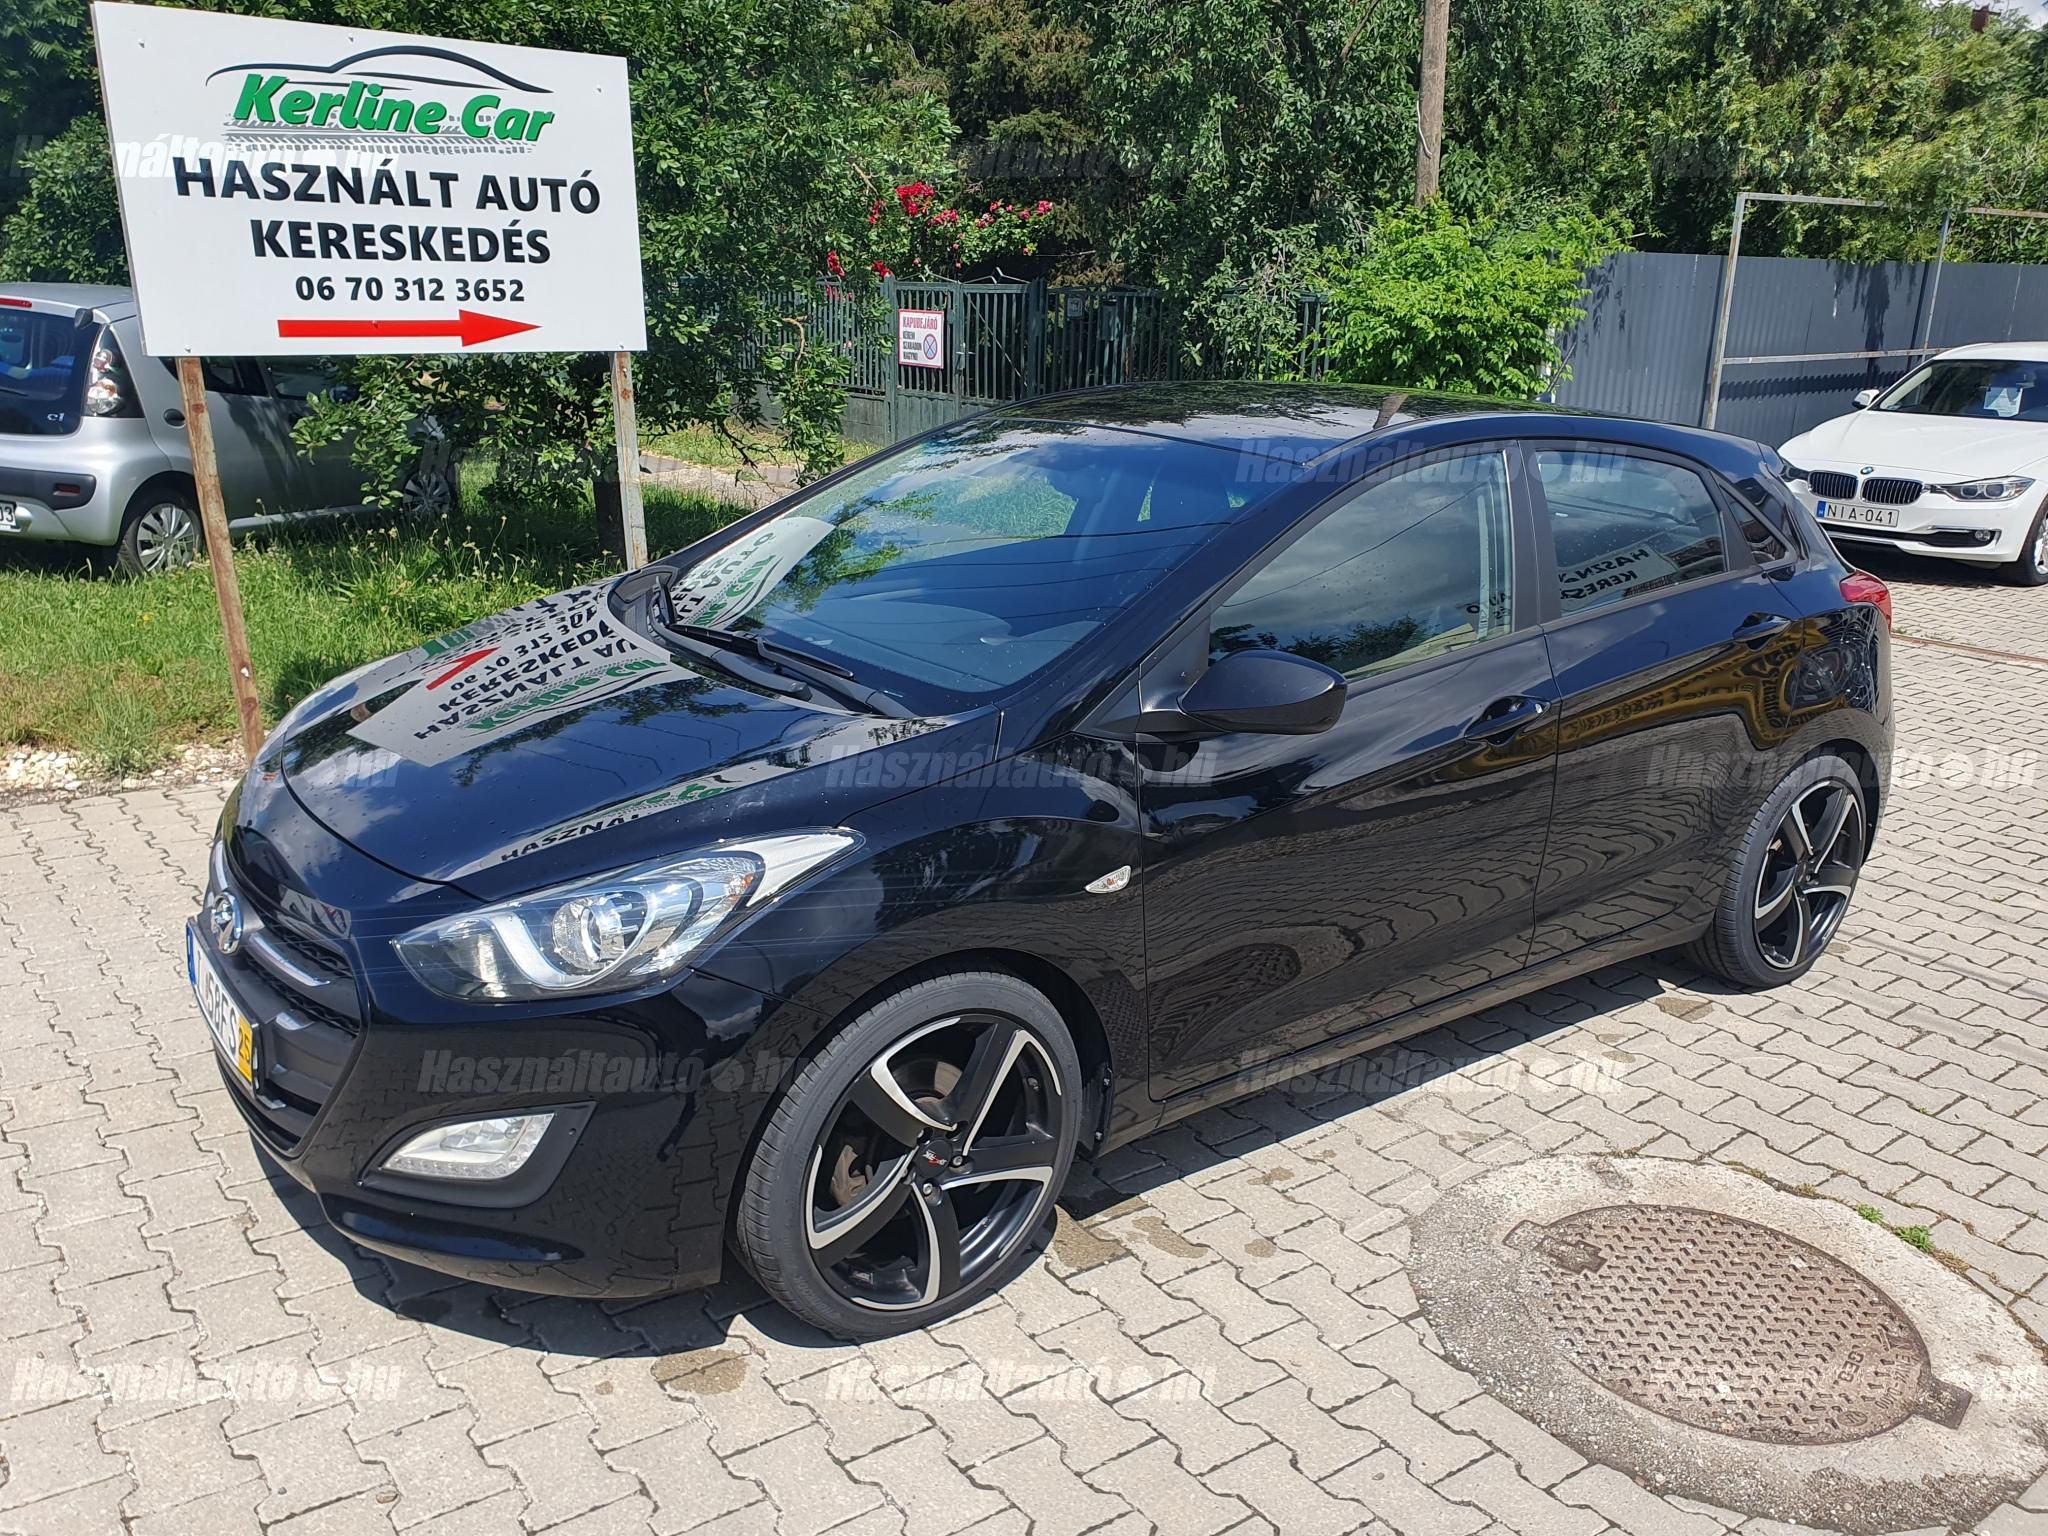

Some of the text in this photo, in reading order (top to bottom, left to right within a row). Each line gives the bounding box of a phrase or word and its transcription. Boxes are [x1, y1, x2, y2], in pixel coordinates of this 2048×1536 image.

[233, 73, 555, 143] Kerline Car
[173, 156, 600, 214] HASZNÁLT AUTÓ
[250, 218, 551, 264] KERESKEDÉS
[296, 275, 525, 302] 06 70 312 3652
[1828, 505, 1893, 524] NIA-041
